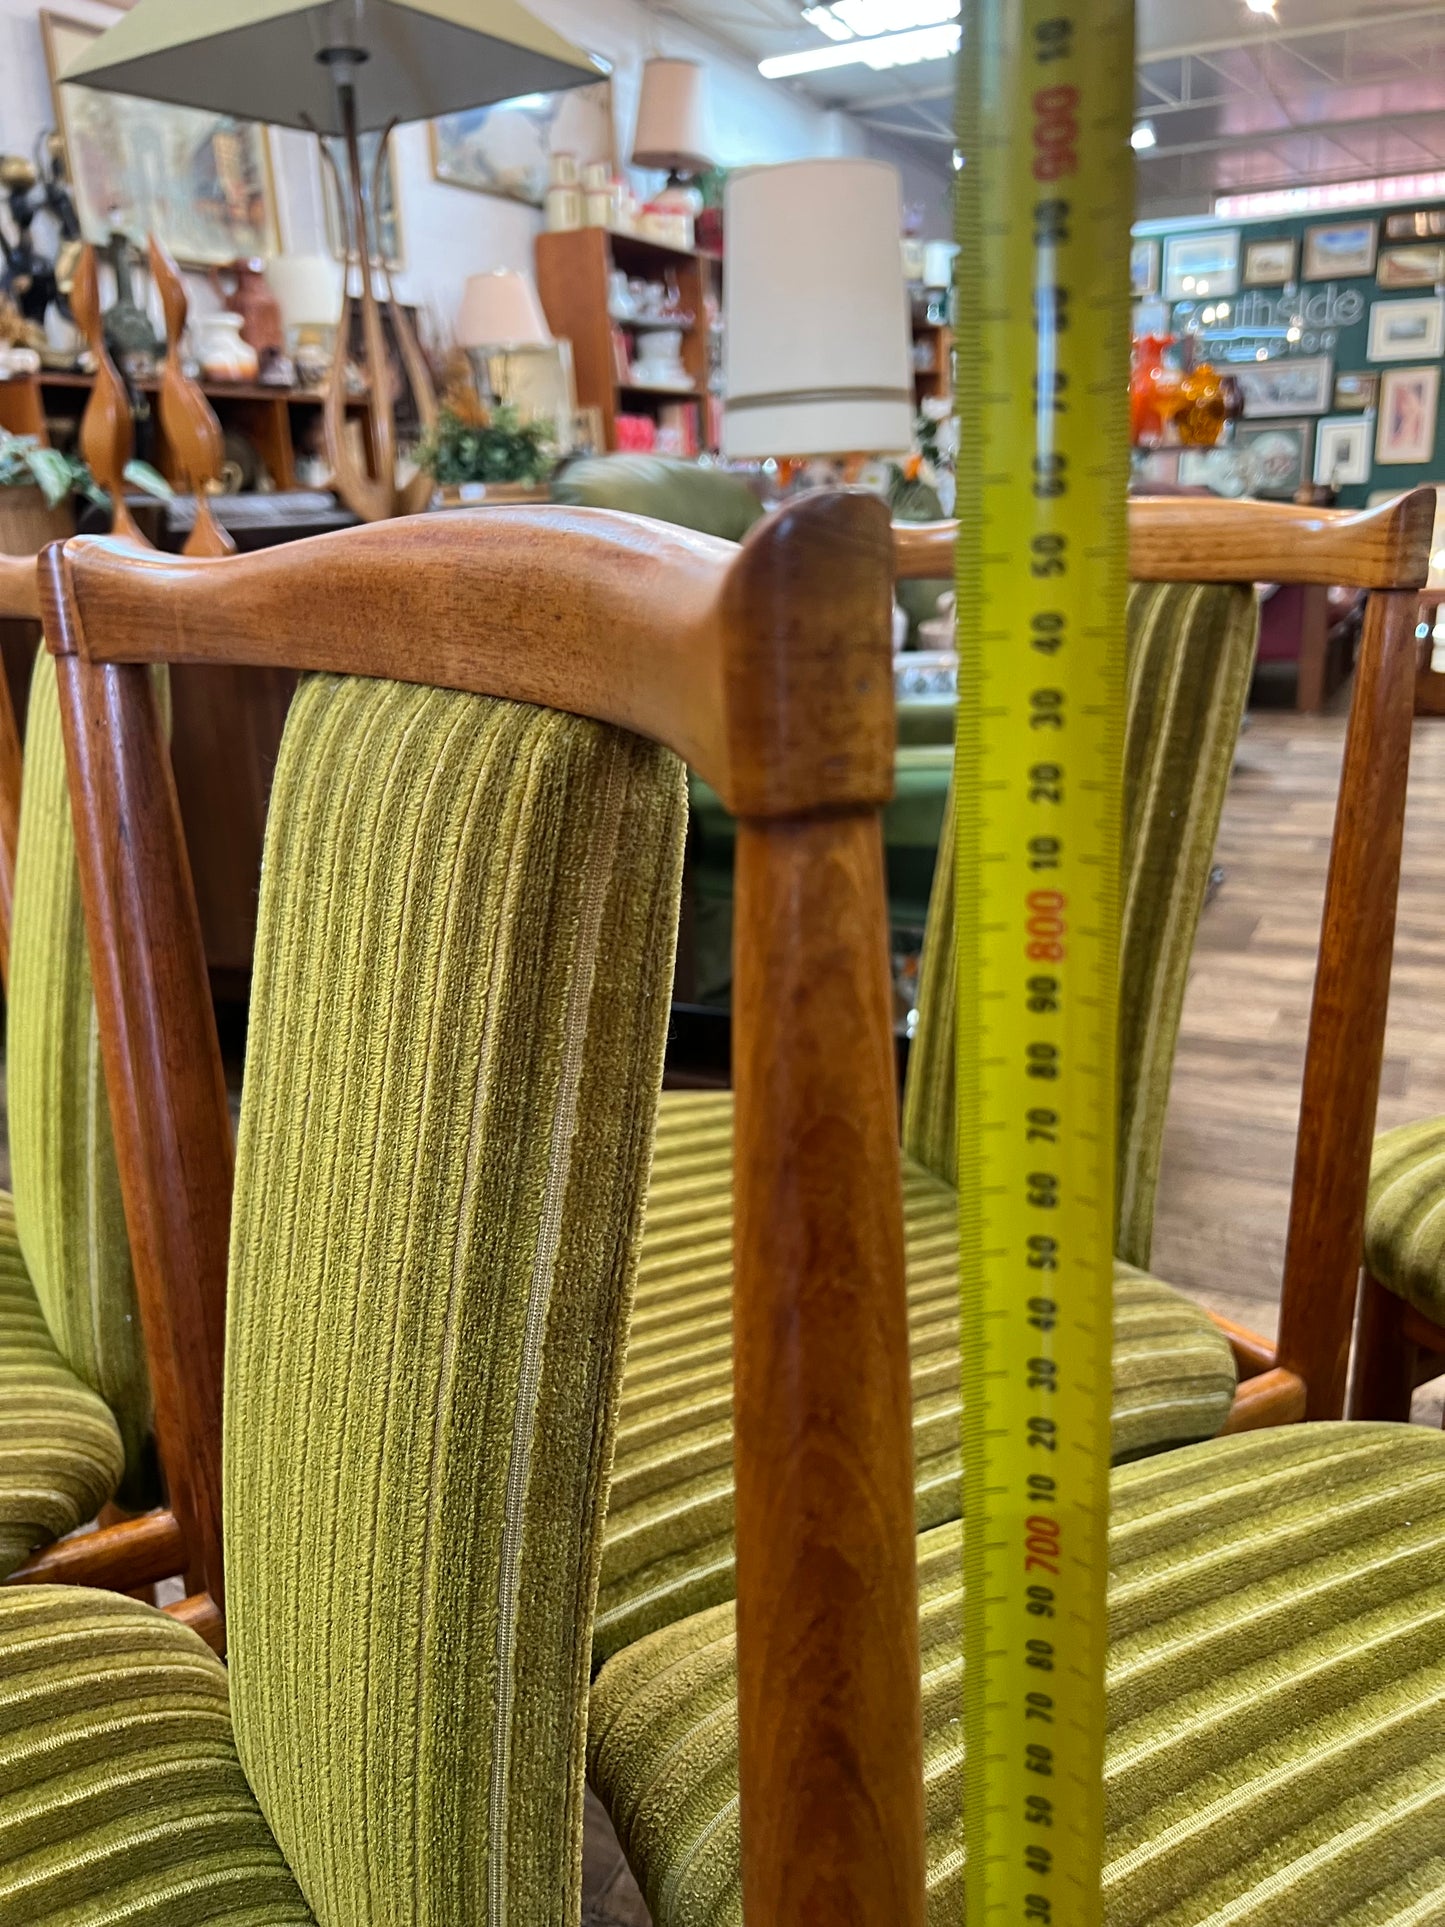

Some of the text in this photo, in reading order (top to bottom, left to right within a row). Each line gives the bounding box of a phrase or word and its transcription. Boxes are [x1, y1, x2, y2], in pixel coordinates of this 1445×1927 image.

[1032, 85, 1079, 181] 900
[1030, 532, 1066, 578] 50
[1030, 611, 1065, 655] 40
[1030, 688, 1064, 731] 30
[1028, 763, 1062, 805] 20
[1027, 836, 1061, 871] 10
[1025, 888, 1067, 964] 800
[1026, 975, 1059, 1014] 90
[1025, 1042, 1059, 1081] 80
[1025, 1107, 1058, 1144] 70
[1026, 1171, 1059, 1209] 60
[1026, 1234, 1058, 1272] 50
[1026, 1297, 1057, 1332] 40
[1026, 1356, 1057, 1393] 30
[1026, 1415, 1056, 1452] 20
[1026, 1473, 1056, 1503] 10
[1024, 1515, 1060, 1575] 700
[1025, 1584, 1054, 1619] 90
[1025, 1638, 1054, 1672] 80
[1025, 1690, 1054, 1724] 70
[1024, 1742, 1053, 1778] 60
[1024, 1794, 1053, 1835] 50
[1024, 1844, 1052, 1877] 40
[1024, 1892, 1051, 1925] 30
